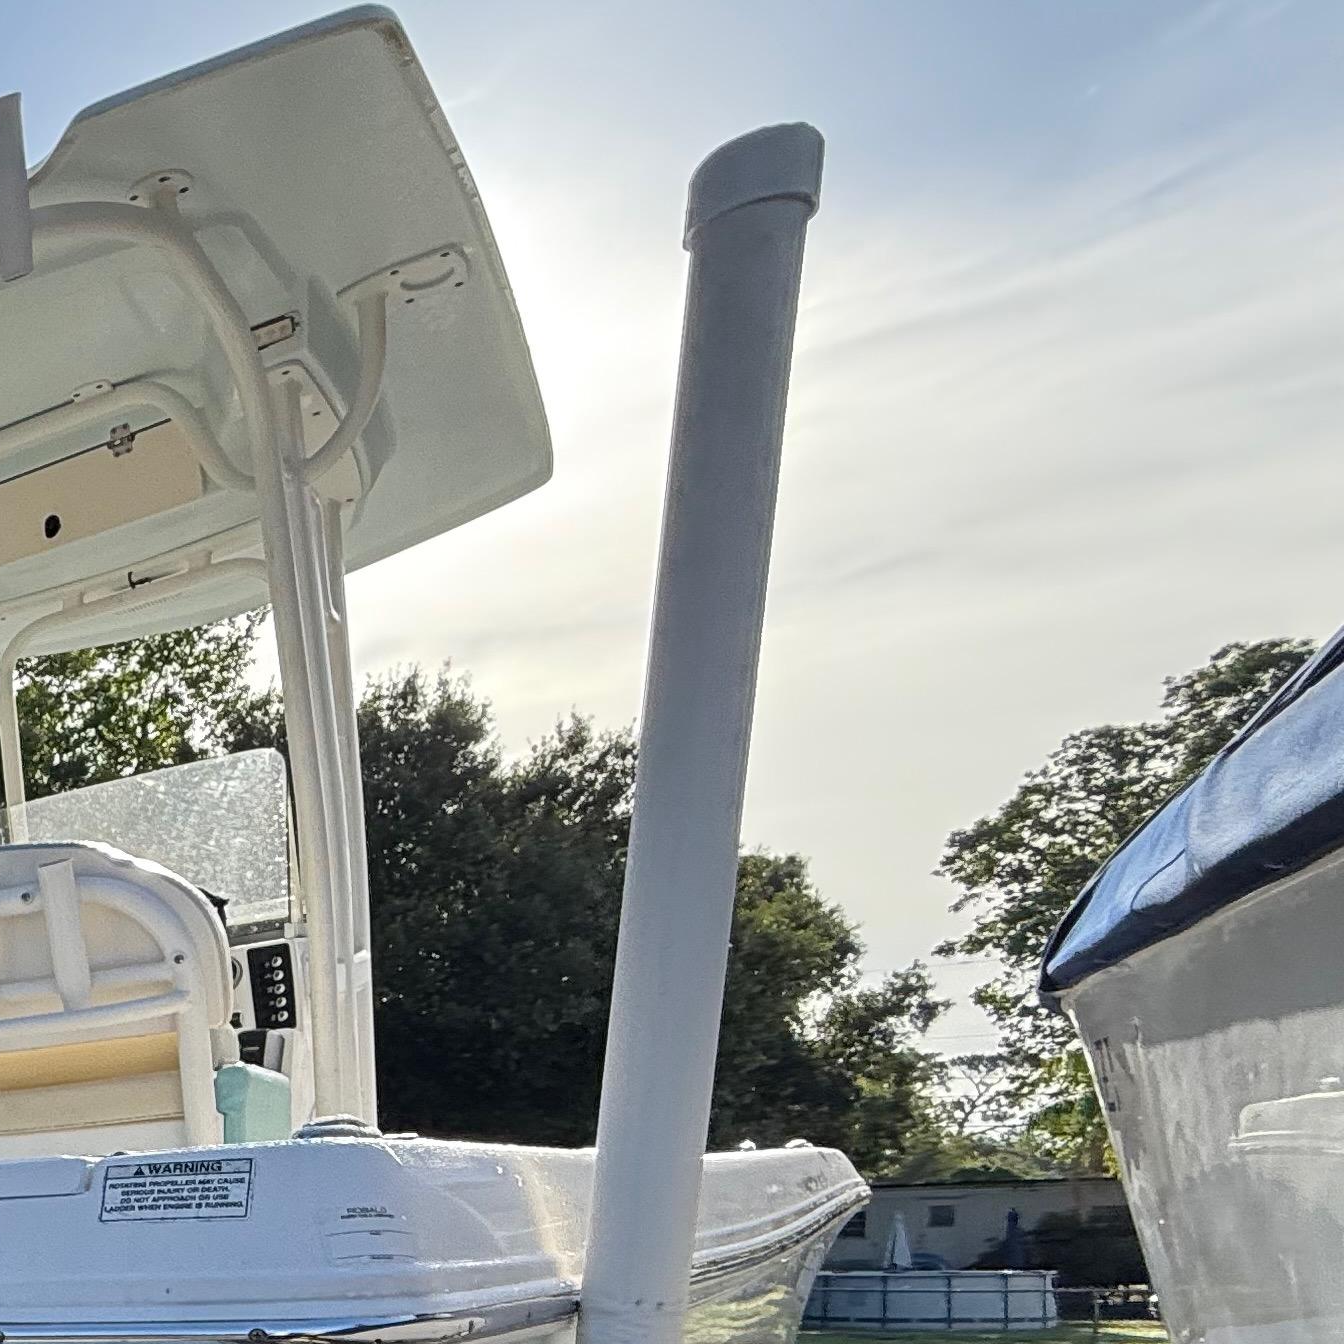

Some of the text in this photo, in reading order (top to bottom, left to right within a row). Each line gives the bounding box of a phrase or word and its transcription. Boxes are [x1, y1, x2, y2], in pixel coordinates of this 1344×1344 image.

[148, 1160, 223, 1175] WARNING
[108, 1181, 147, 1190] ROTATING
[148, 1179, 197, 1187] PROPELLER
[157, 1187, 185, 1195] INJURY
[151, 1195, 197, 1203] APPROACH
[104, 1204, 135, 1213] LADDER
[163, 1202, 193, 1210] ENGINE
